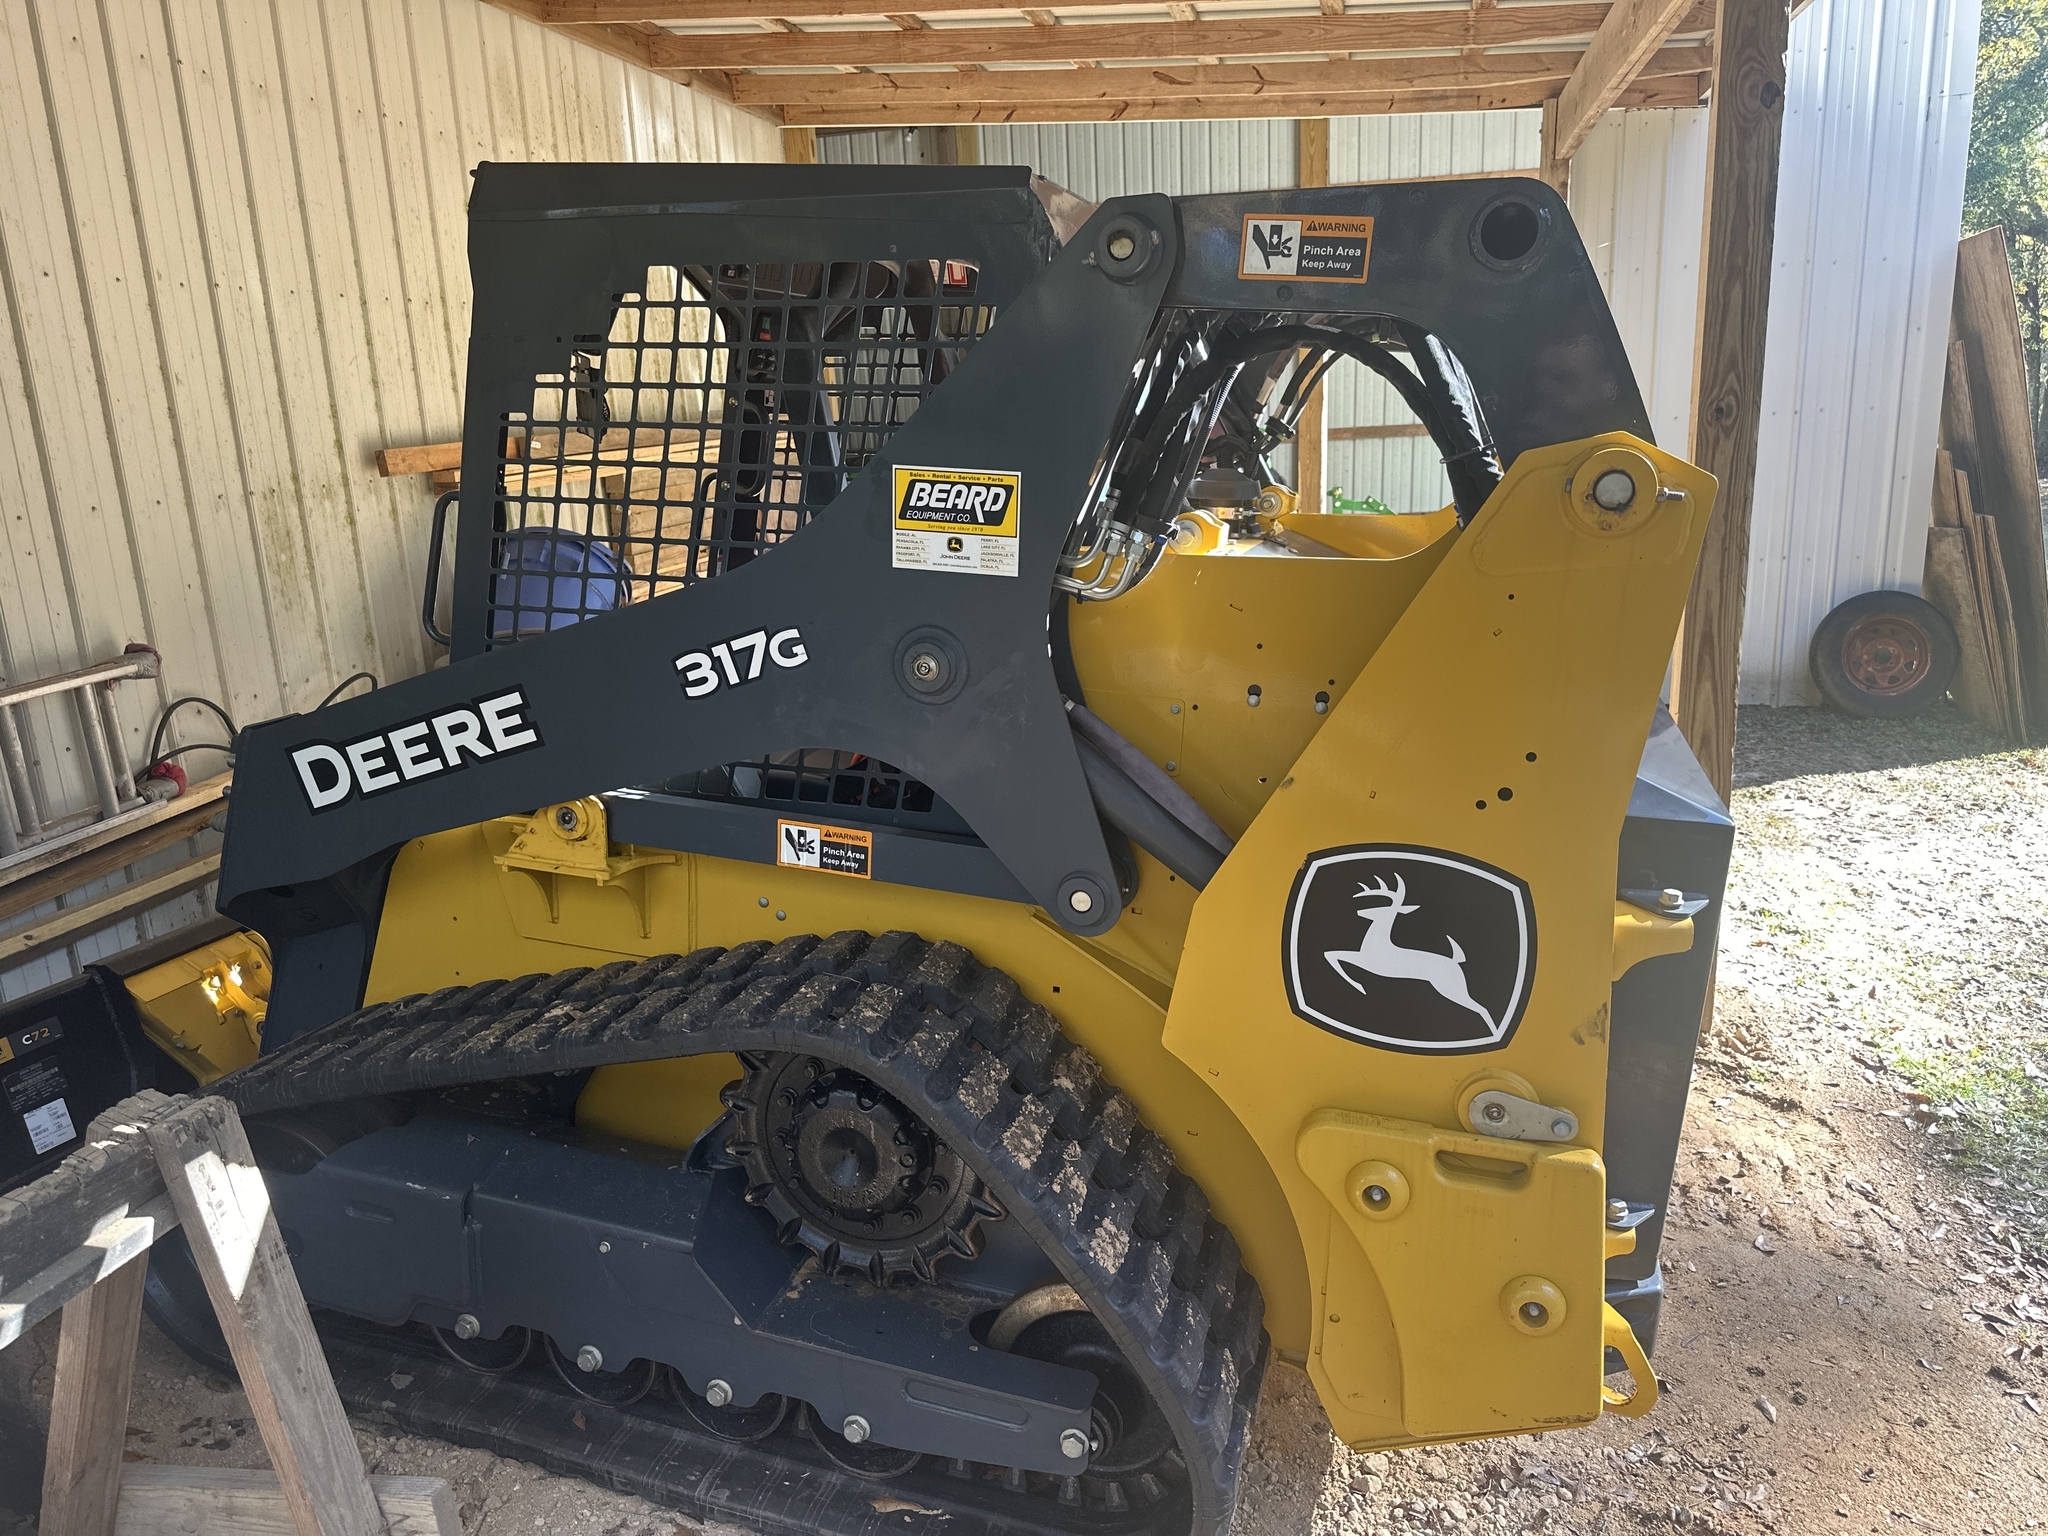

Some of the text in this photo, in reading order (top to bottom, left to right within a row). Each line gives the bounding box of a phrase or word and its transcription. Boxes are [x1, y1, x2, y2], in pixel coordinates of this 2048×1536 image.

[1317, 222, 1366, 232] WARNING
[1303, 245, 1361, 256] Pinch Area
[1302, 259, 1351, 271] Keep Away
[909, 482, 1006, 523] BEARD
[906, 510, 971, 522] EQUIPMENT CO.
[927, 523, 946, 531] Serving
[675, 628, 809, 697] 317G
[291, 691, 538, 809] DEERE
[831, 831, 867, 843] WARNING
[823, 846, 865, 860] Pinch Area
[822, 856, 859, 869] Keep Away
[22, 1027, 51, 1045] C72
